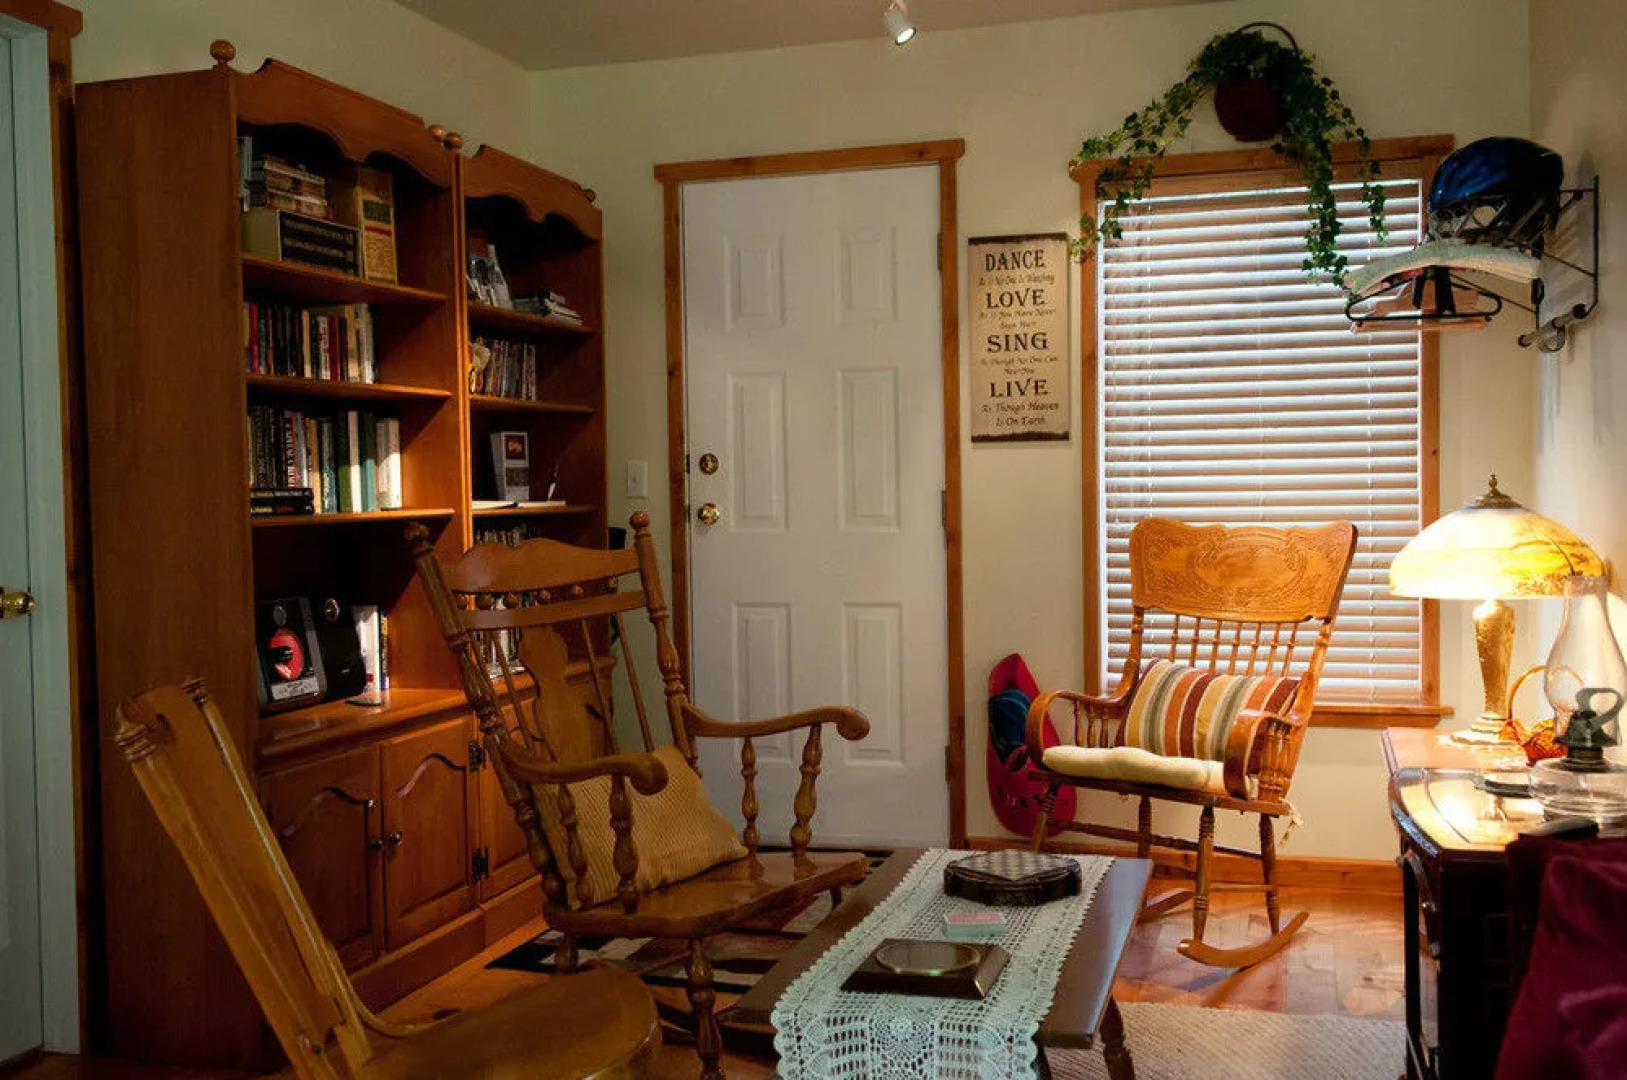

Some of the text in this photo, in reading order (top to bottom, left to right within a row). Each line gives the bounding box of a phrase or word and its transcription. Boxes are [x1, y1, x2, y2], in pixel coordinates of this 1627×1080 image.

[985, 249, 1045, 271] DANCE
[986, 287, 1045, 309] LOVE
[987, 332, 1048, 353] SING
[990, 377, 1050, 398] LIVE
